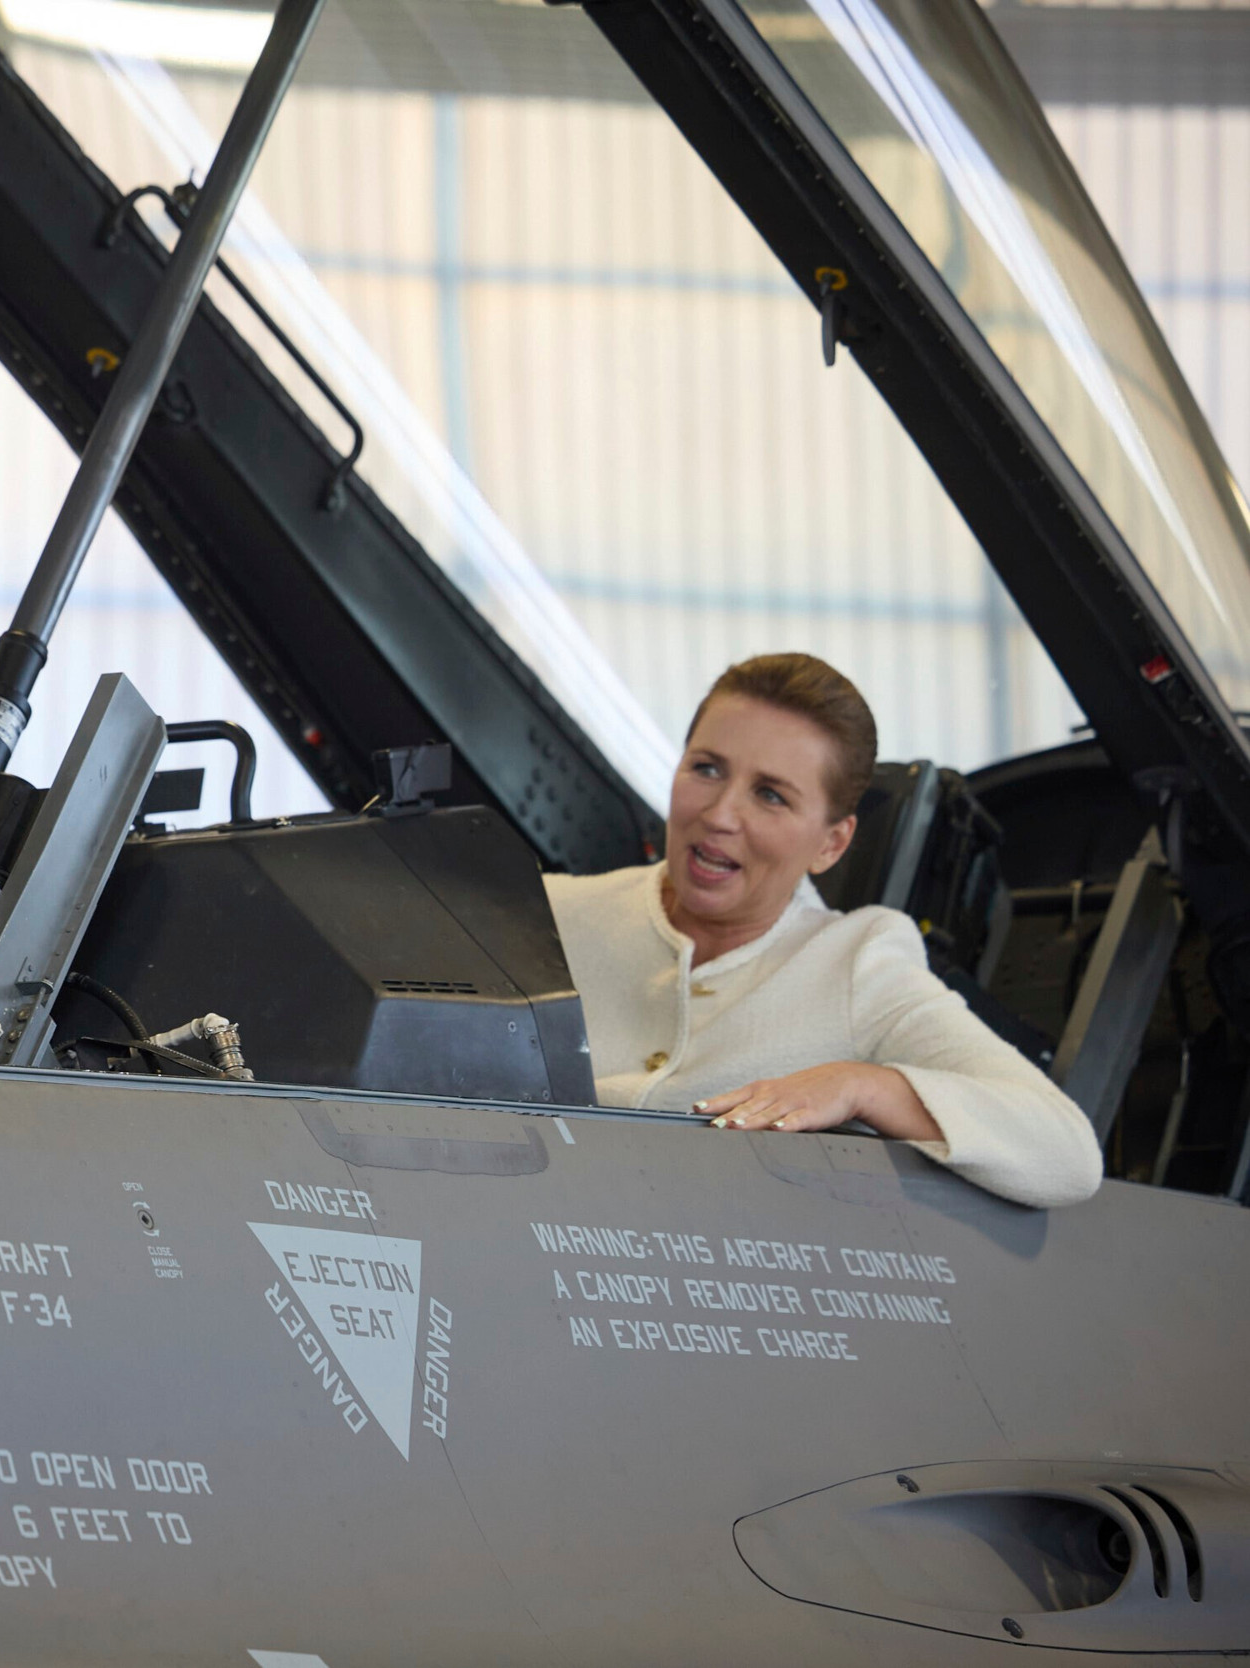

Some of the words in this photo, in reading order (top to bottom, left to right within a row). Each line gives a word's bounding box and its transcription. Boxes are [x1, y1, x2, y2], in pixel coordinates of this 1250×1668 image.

[122, 1182, 143, 1191] OPEN
[263, 1180, 377, 1220] DANGER
[148, 1246, 173, 1256] CLOSE
[151, 1257, 181, 1267] MANUAL
[724, 1239, 832, 1273] AIRCRAFT
[840, 1248, 956, 1284] CONTAINS
[155, 1268, 183, 1279] CANOPY
[283, 1251, 414, 1294] EJECTION
[1, 1290, 72, 1328] F-34
[552, 1270, 572, 1299] A
[576, 1271, 673, 1306] CANOPY
[684, 1278, 806, 1315] REMOVER
[811, 1288, 952, 1324] CONTAINING
[330, 1304, 396, 1340] SEAT
[569, 1316, 603, 1347] AN
[609, 1319, 751, 1355] EXPLOSIVE
[756, 1327, 859, 1361] CHARGE
[264, 1281, 369, 1434] DANGER
[423, 1297, 452, 1439] DANGER
[31, 1451, 116, 1490] OPEN
[128, 1457, 213, 1495] DOOR
[13, 1505, 39, 1539] 6
[50, 1507, 132, 1542] FEET
[148, 1511, 192, 1545] TO
